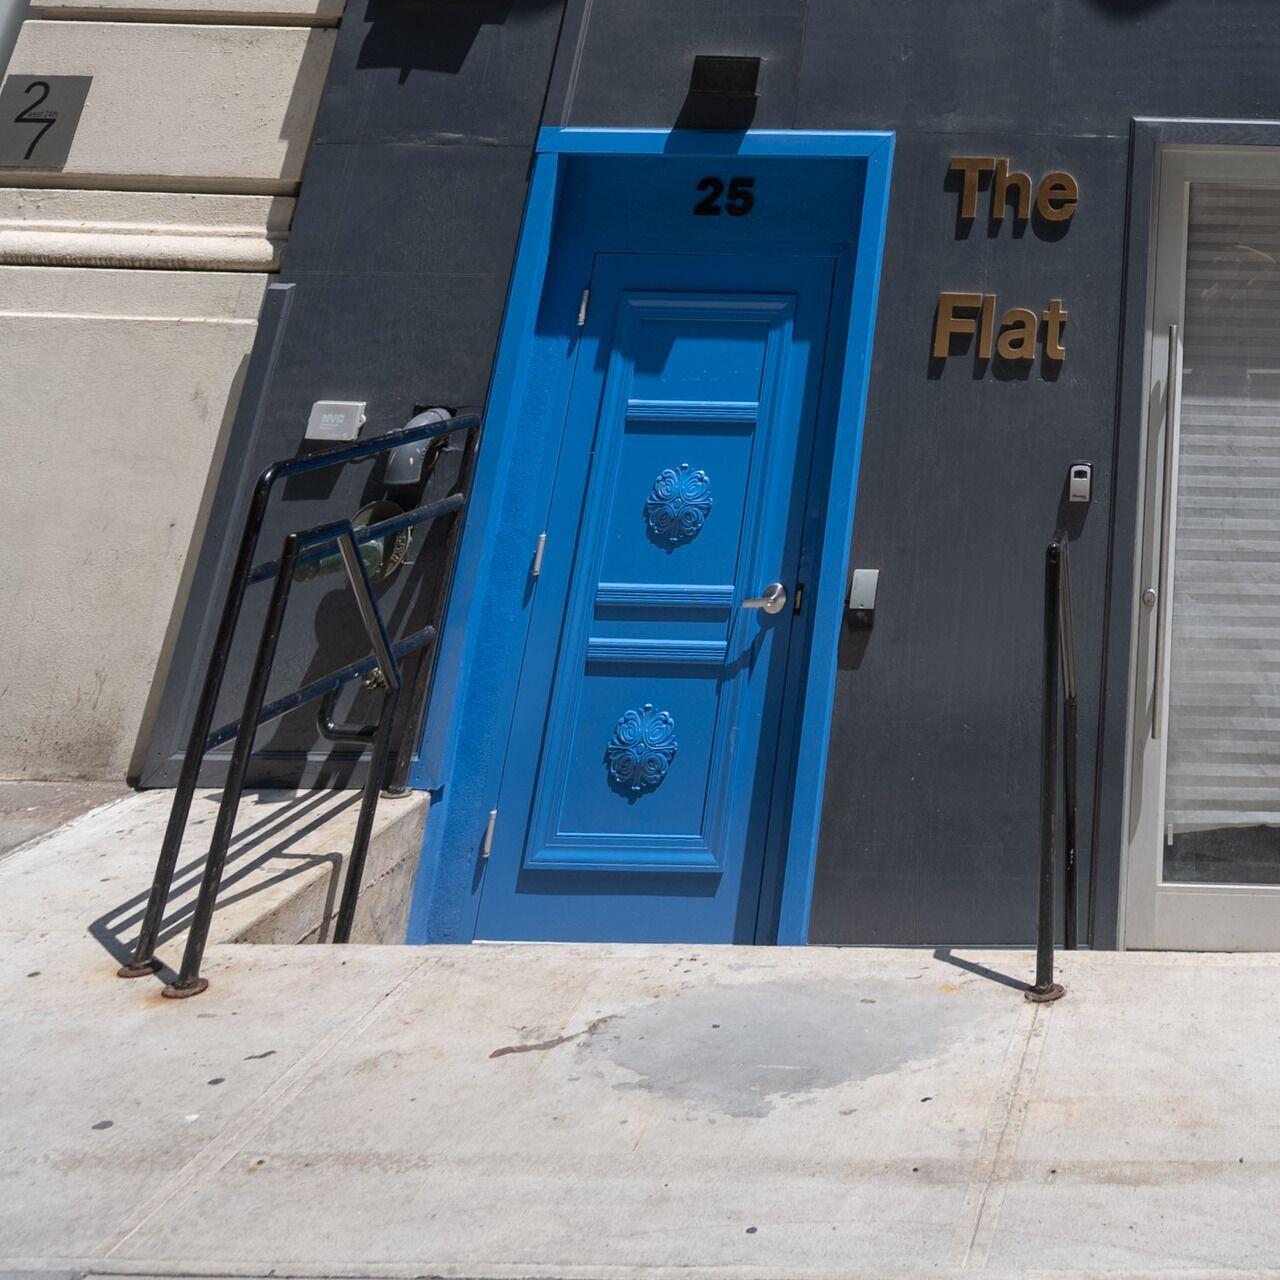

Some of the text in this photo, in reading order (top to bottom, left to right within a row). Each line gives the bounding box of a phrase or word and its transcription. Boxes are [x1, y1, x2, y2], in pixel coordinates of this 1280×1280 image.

[14, 81, 56, 160] 27
[692, 176, 755, 217] 25
[949, 156, 1079, 221] The
[933, 292, 1068, 361] Flat
